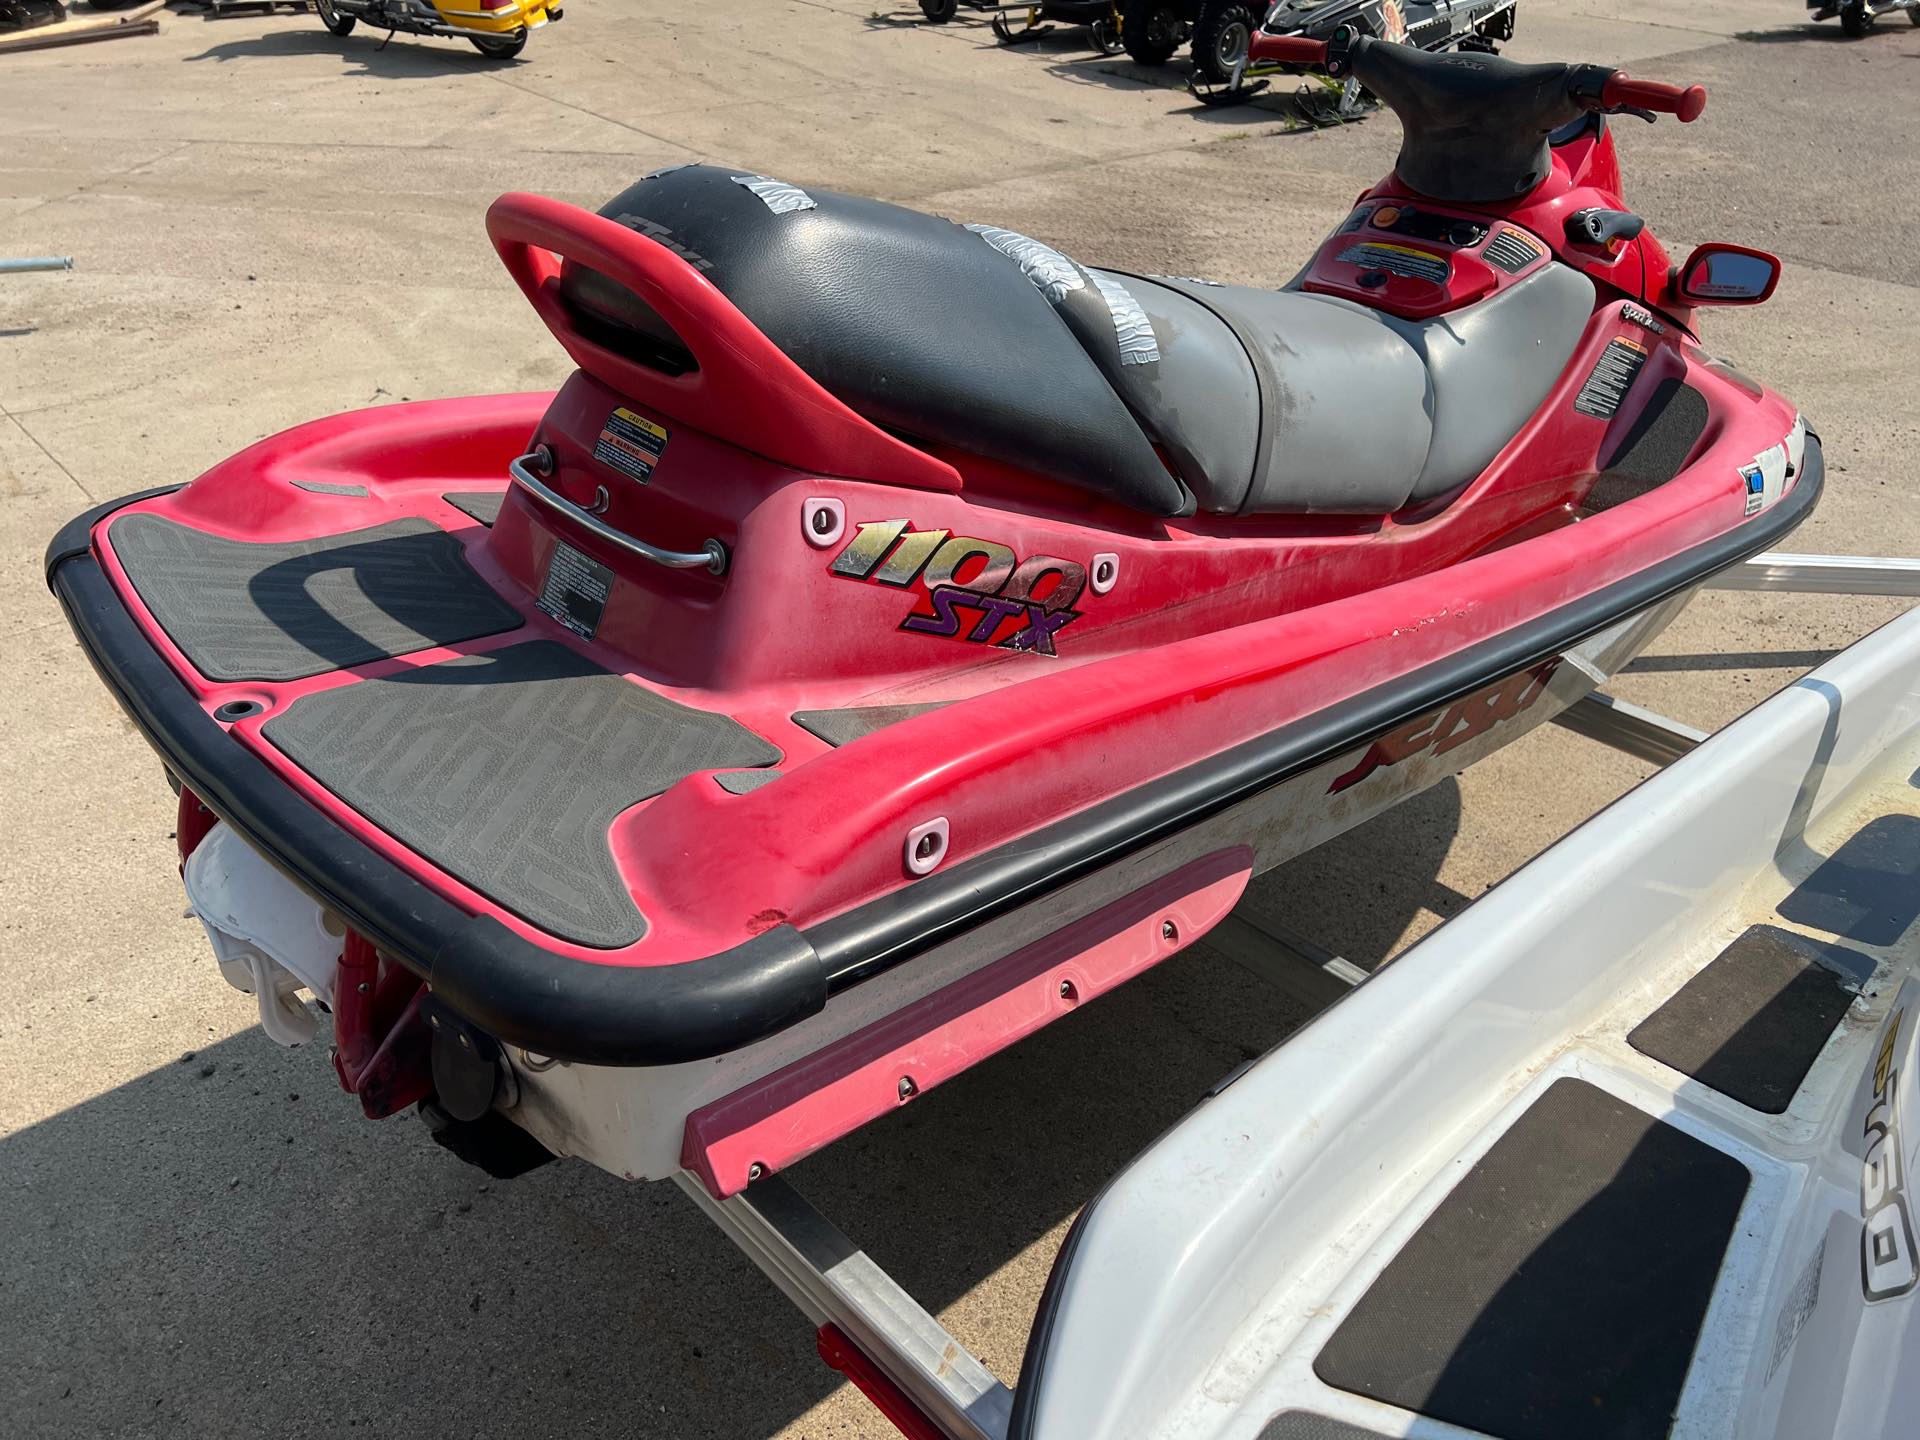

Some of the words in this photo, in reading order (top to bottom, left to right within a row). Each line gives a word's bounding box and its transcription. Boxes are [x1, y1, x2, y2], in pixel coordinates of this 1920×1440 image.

[628, 414, 653, 430] CAUTION
[615, 437, 640, 456] WARNING
[829, 518, 1087, 611] 1100
[899, 586, 1083, 656] STX
